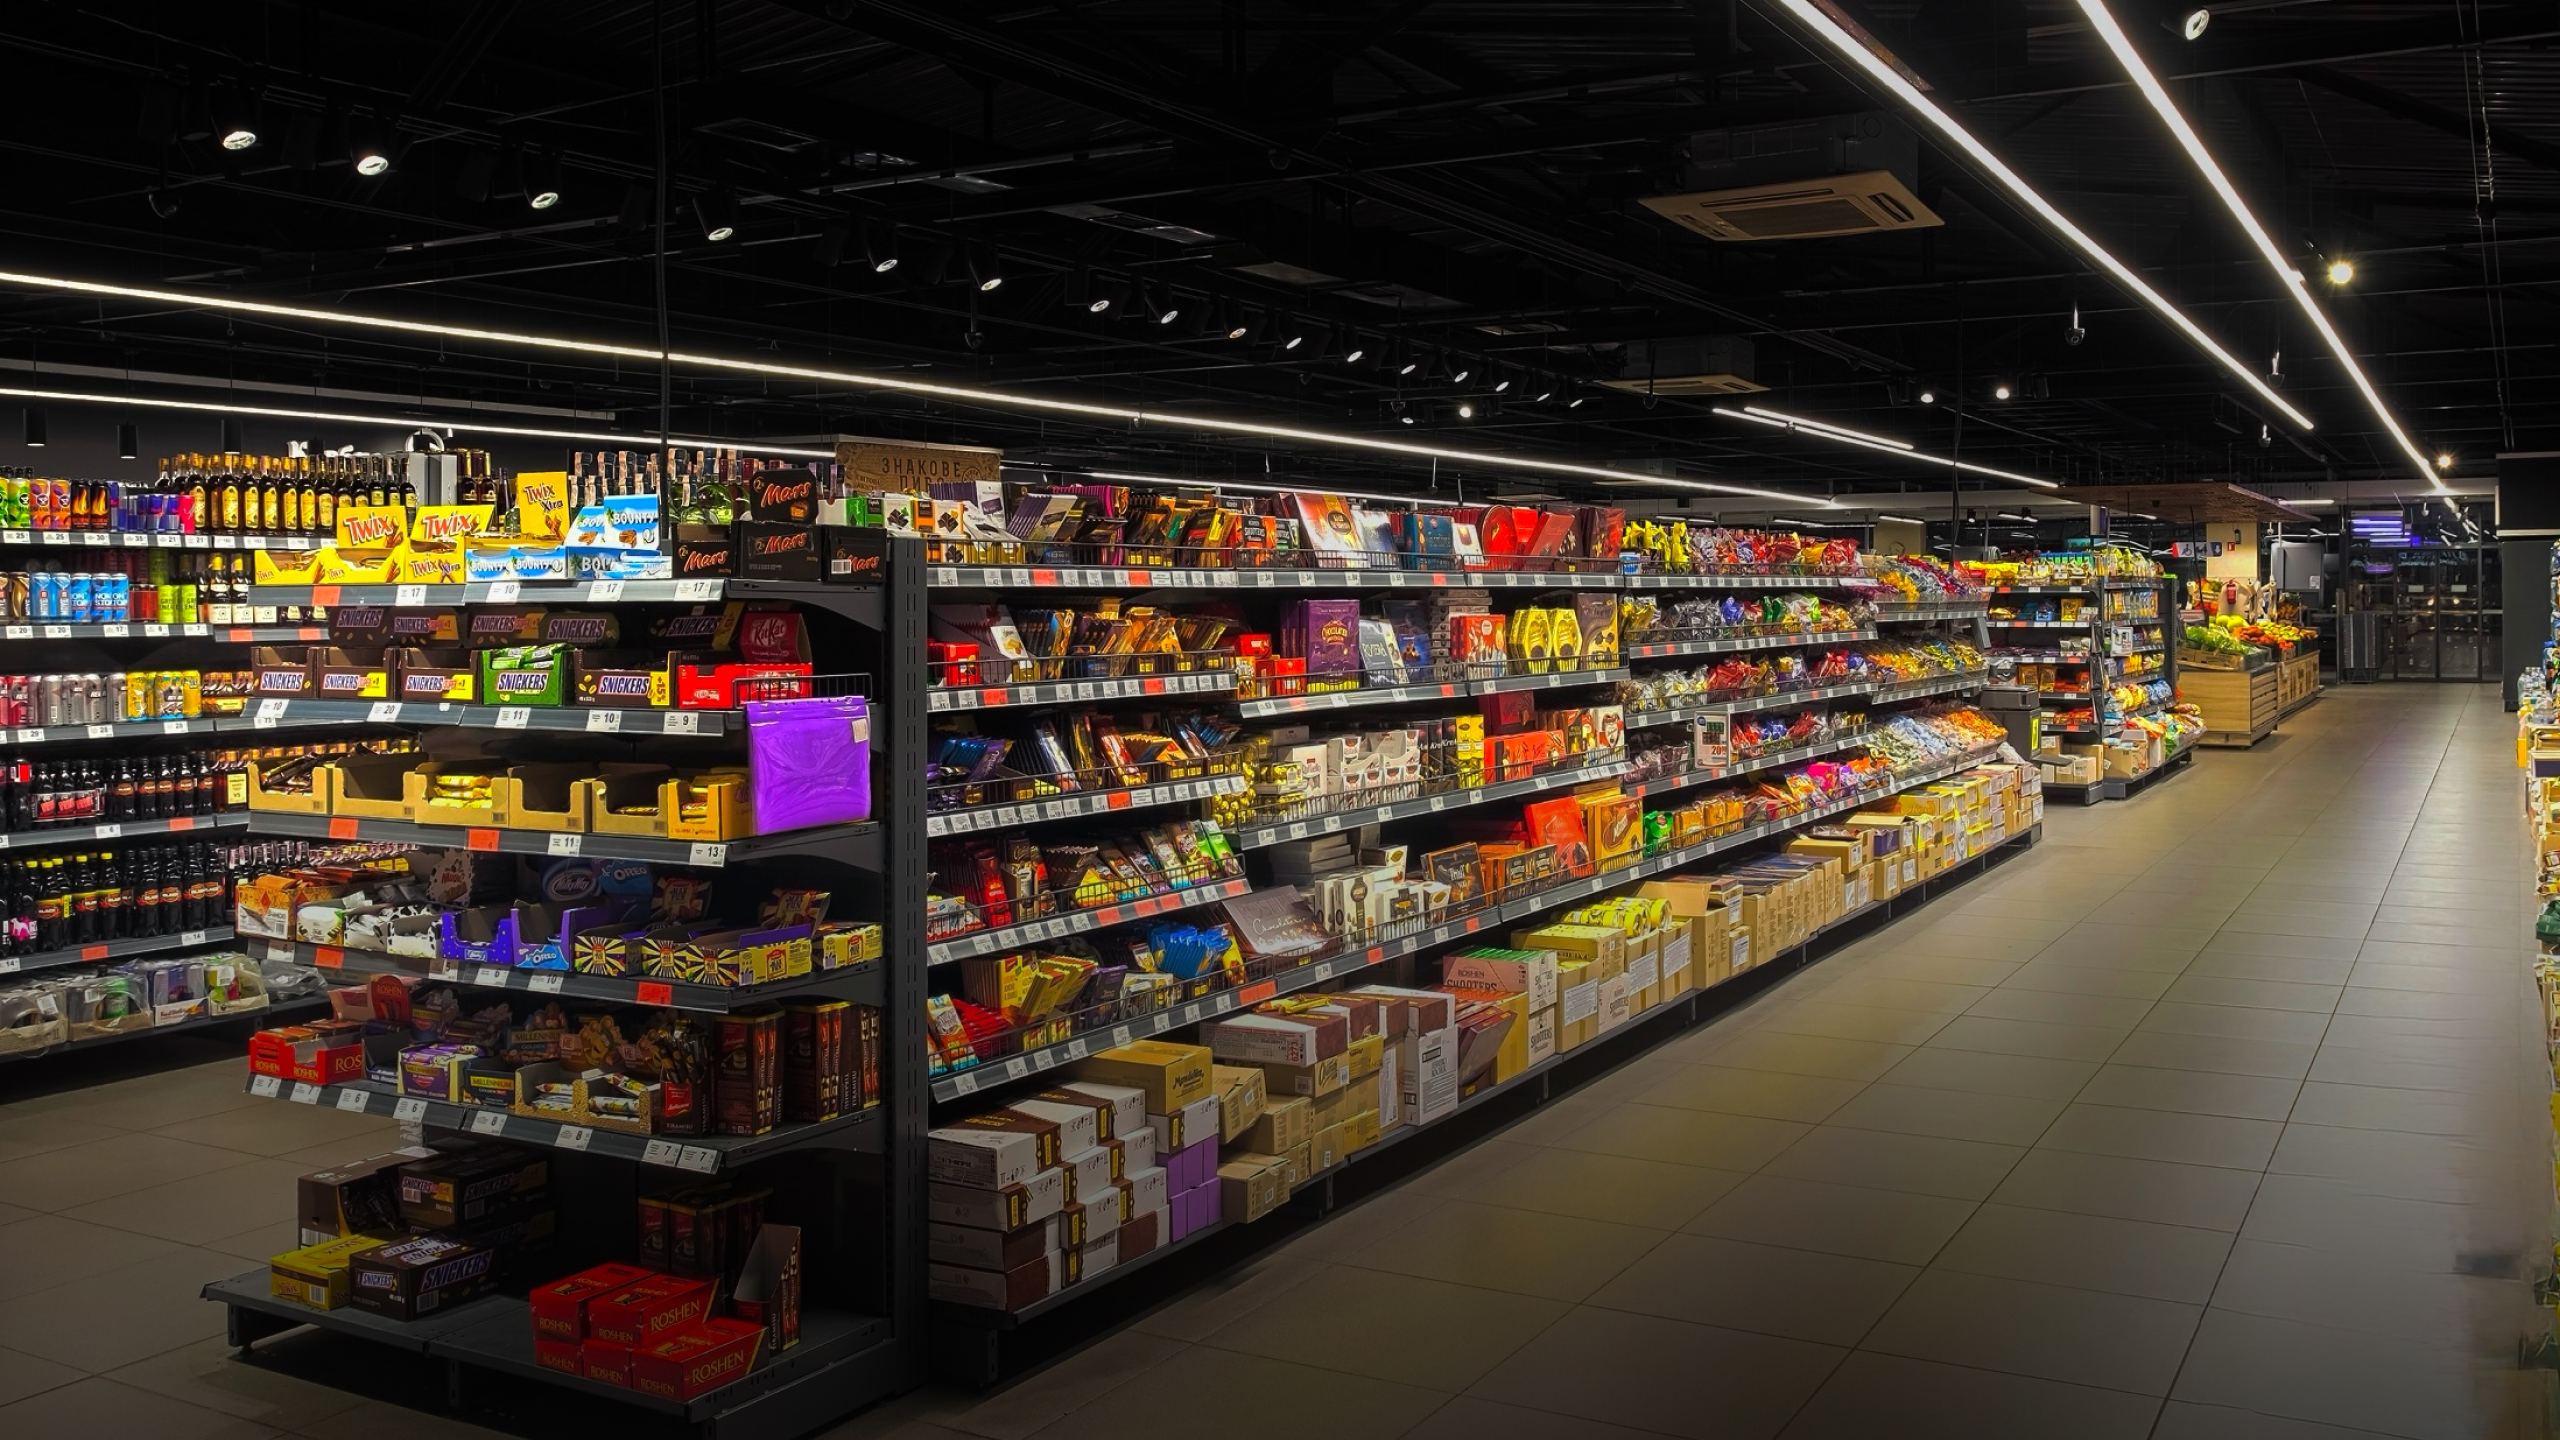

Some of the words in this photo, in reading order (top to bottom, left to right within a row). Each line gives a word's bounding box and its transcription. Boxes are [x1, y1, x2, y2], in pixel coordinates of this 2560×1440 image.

[881, 457, 961, 478] ЗНАКОВЕ
[760, 481, 812, 508] Mars
[582, 516, 605, 527] BOU
[613, 512, 658, 525] BOUNTY
[764, 532, 807, 554] Mars
[471, 561, 503, 572] BOUNTY
[516, 559, 550, 570] BOUNTY
[683, 550, 729, 573] Mars
[411, 588, 421, 597] 17
[607, 583, 617, 593] 17
[694, 583, 704, 592] 17
[338, 609, 383, 627] SNICKERS
[395, 617, 430, 632] SNICKERS
[472, 616, 515, 631] SNICKERS
[549, 619, 606, 639] SNICKERS
[669, 617, 721, 635] SNICKERS
[260, 673, 303, 690] SNICKERS
[325, 675, 359, 689] SNICKERS
[407, 676, 443, 690] SNICKERS
[499, 674, 547, 690] SNICKERS
[600, 676, 649, 694] SNICKERS
[273, 701, 282, 711] 10
[383, 704, 396, 715] 20
[513, 710, 523, 720] 11
[604, 713, 615, 724] 10
[682, 715, 689, 725] 9
[565, 836, 574, 847] 11
[708, 846, 719, 857] 13
[614, 866, 648, 880] OREO
[1458, 969, 1485, 978] ROSHEN
[378, 984, 402, 995] ROSHEN
[514, 1030, 561, 1042] MILLENNIU
[255, 1060, 281, 1073] ROSHEN
[335, 1055, 362, 1072] ROS
[293, 1066, 318, 1079] ROSHEN
[267, 1079, 273, 1088] 7
[472, 1077, 514, 1088] MILLENNIUM
[664, 1145, 671, 1156] 7
[701, 1152, 707, 1162] 7
[402, 1177, 431, 1193] SNICKERS
[422, 1250, 493, 1291] SNICKERS
[362, 1272, 392, 1289] SNICKERS
[651, 1300, 700, 1333] ROSHEN
[539, 1316, 572, 1332] ROSHEN
[599, 1328, 633, 1343] ROSHEN
[543, 1355, 574, 1370] ROSHEN
[692, 1350, 744, 1384] ROSHEN
[591, 1365, 623, 1382] ROSHEN
[640, 1378, 675, 1394] ROSHEN
